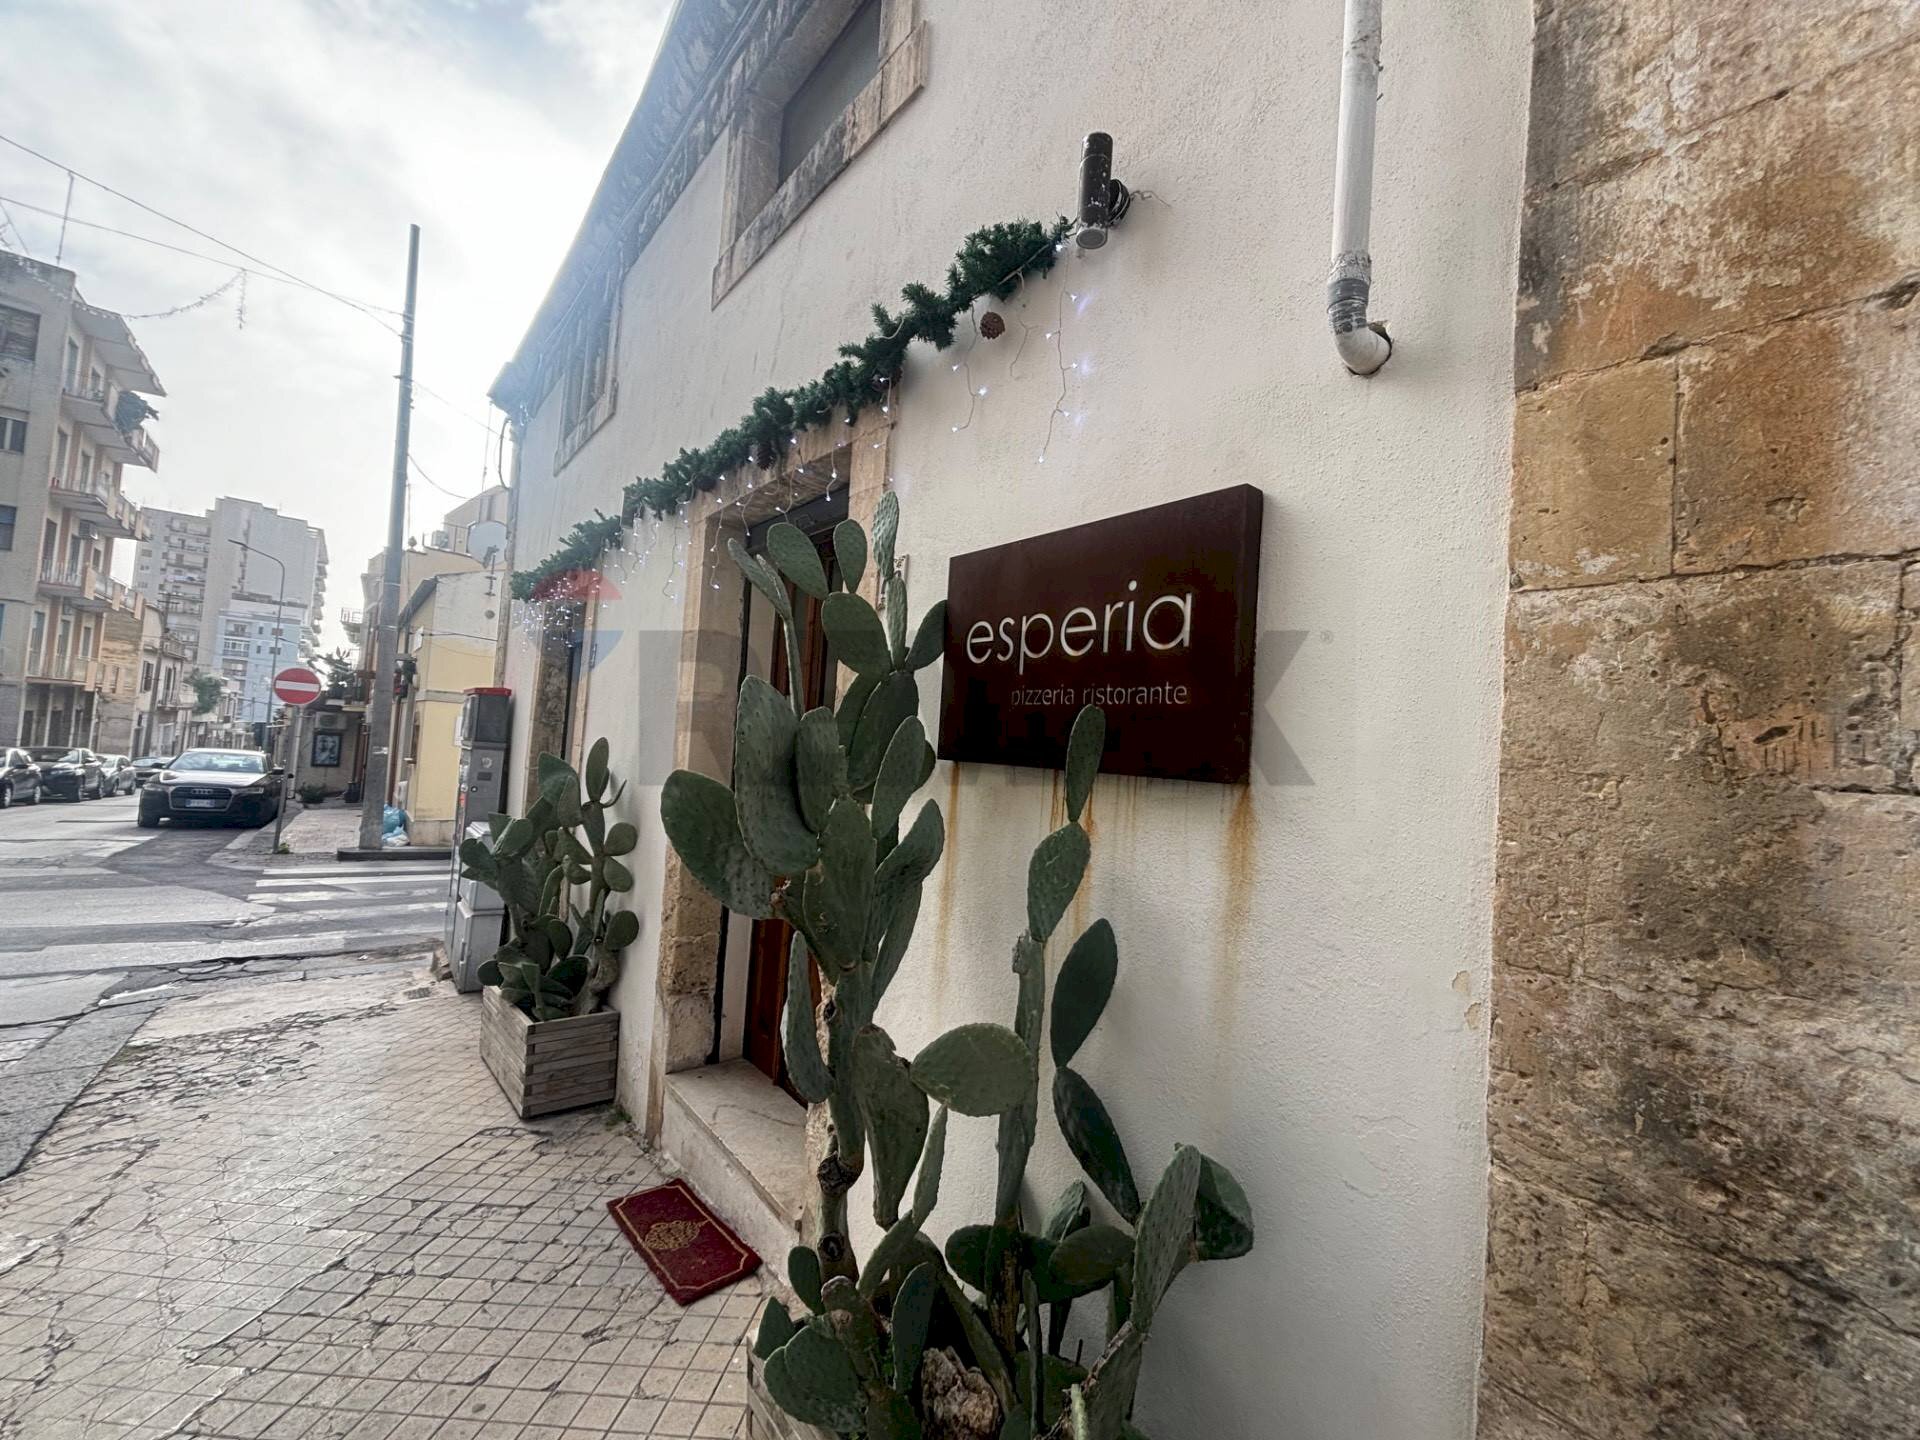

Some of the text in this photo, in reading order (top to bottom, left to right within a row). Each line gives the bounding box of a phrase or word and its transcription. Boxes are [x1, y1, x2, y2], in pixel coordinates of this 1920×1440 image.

[966, 580, 1193, 675] esperia
[1011, 681, 1188, 708] pizzeria ristorante
